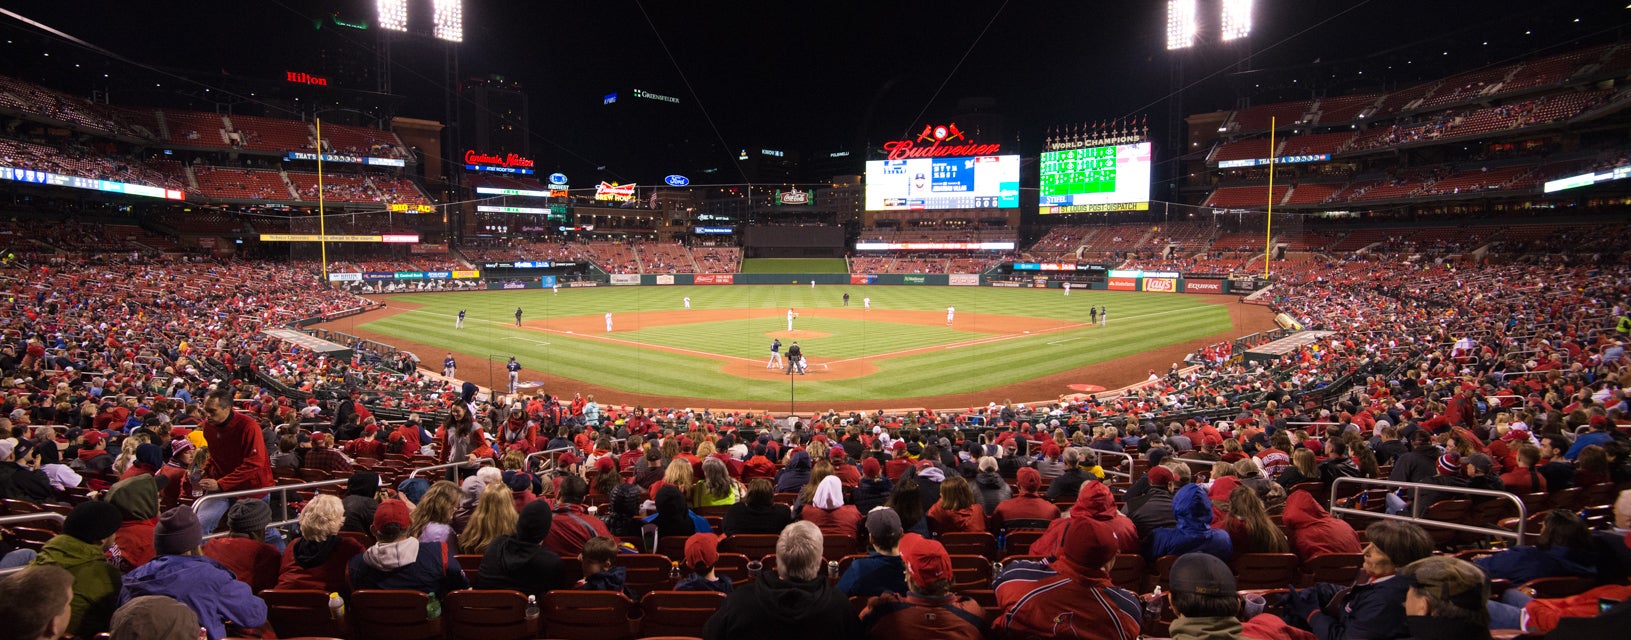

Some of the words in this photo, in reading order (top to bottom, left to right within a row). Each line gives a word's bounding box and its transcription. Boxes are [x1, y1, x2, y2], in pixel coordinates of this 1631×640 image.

[287, 72, 327, 86] Hilton
[641, 91, 680, 104] GREENSFELDER
[883, 139, 1001, 160] Budweiser
[1052, 141, 1082, 150] WORLD
[1085, 136, 1140, 147] CHAMPIONS
[465, 150, 502, 166] Cardinals
[502, 153, 534, 167] Nation
[392, 203, 408, 211] BIG
